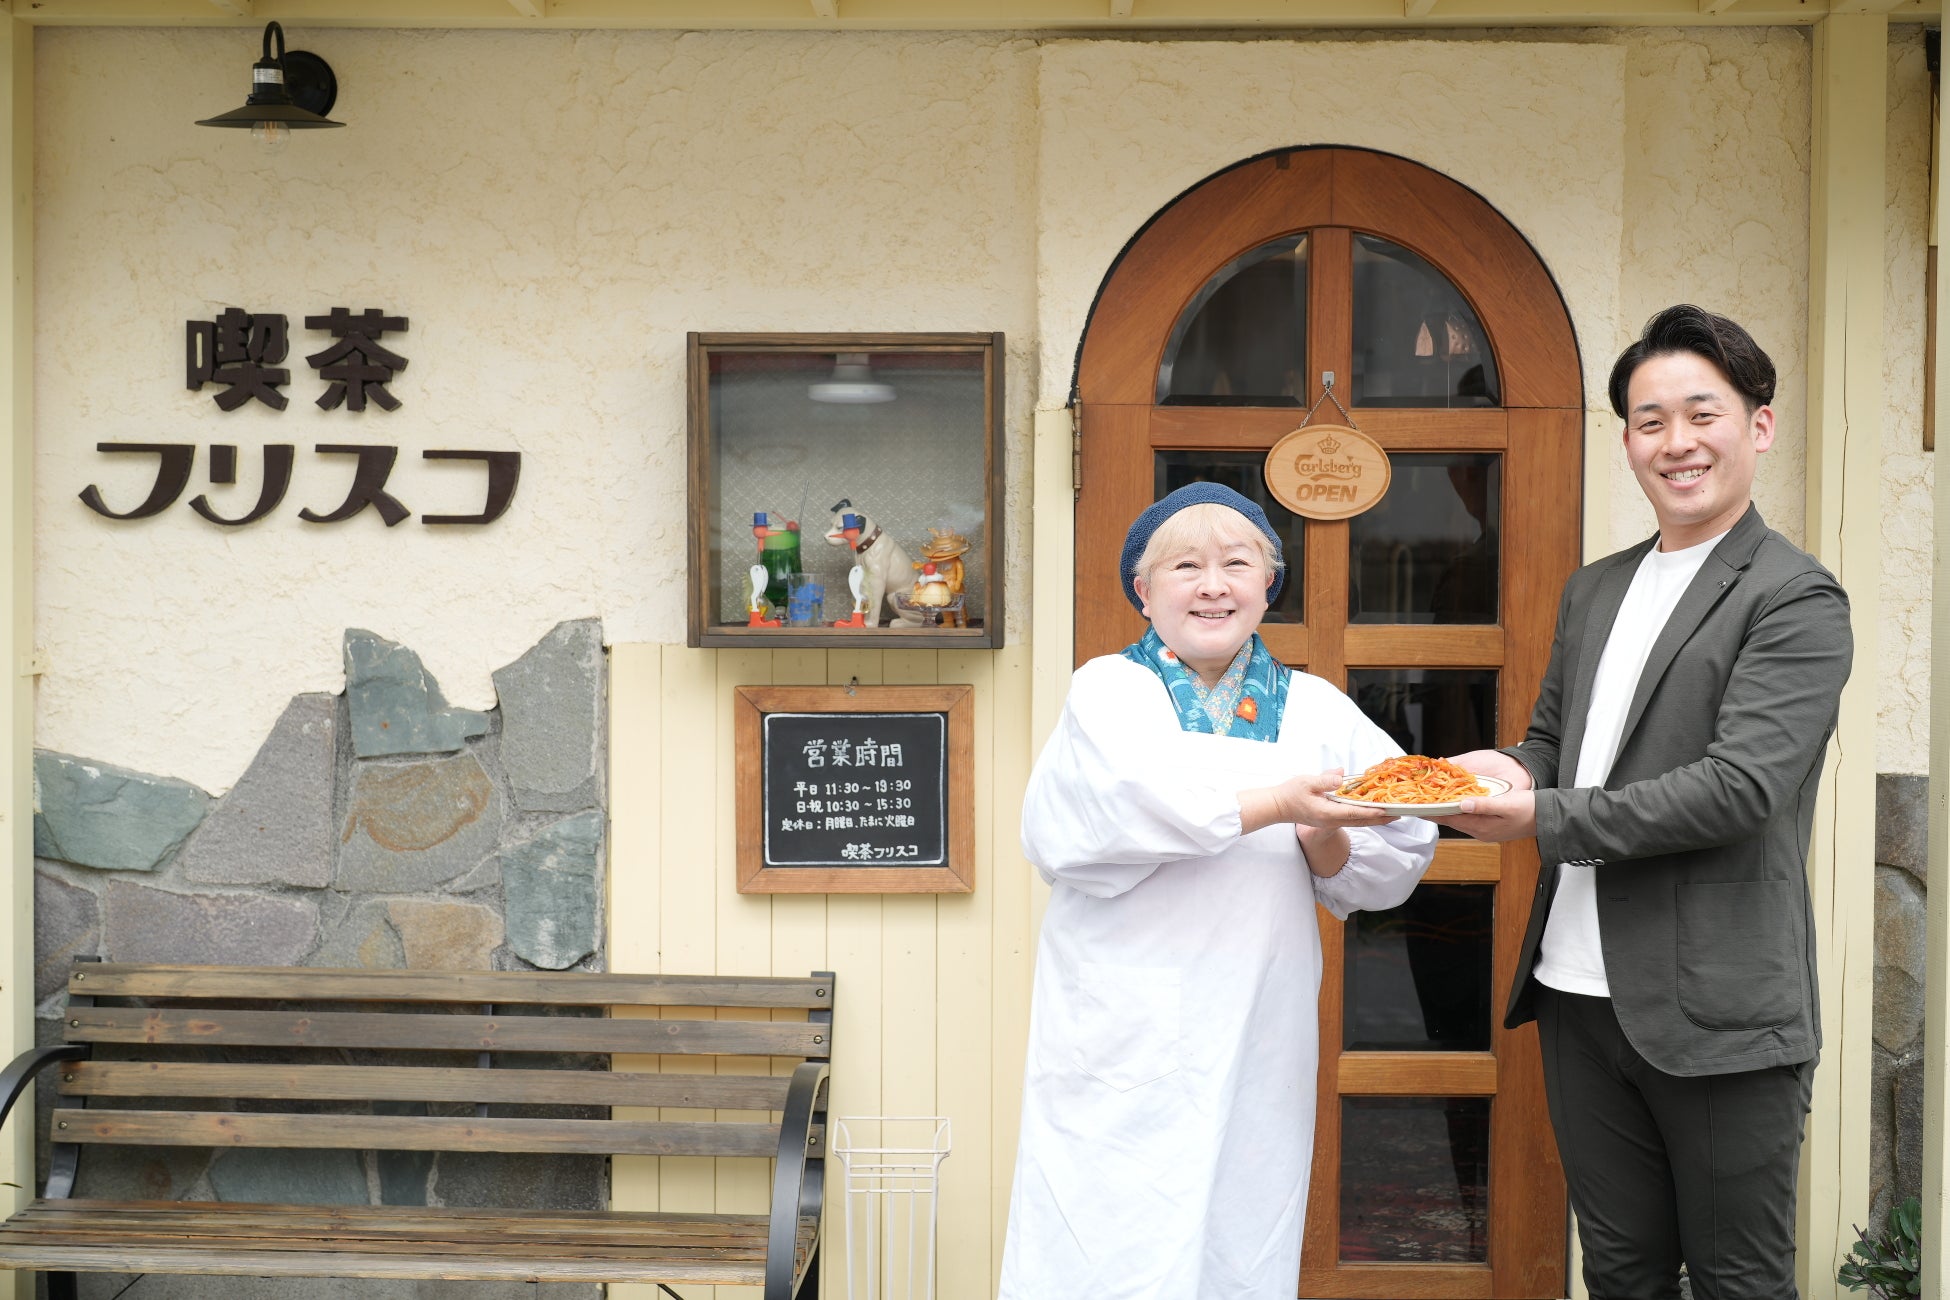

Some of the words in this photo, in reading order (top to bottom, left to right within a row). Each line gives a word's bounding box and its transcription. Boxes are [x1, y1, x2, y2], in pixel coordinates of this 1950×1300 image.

[186, 307, 410, 412] 喫茶
[1294, 454, 1362, 481] Carlsberg
[78, 442, 522, 528] フリスコ
[1296, 484, 1358, 503] OPEN
[802, 737, 904, 769] 営業時間
[793, 781, 818, 798] 平日
[841, 842, 919, 861] 喫茶フリスコ
